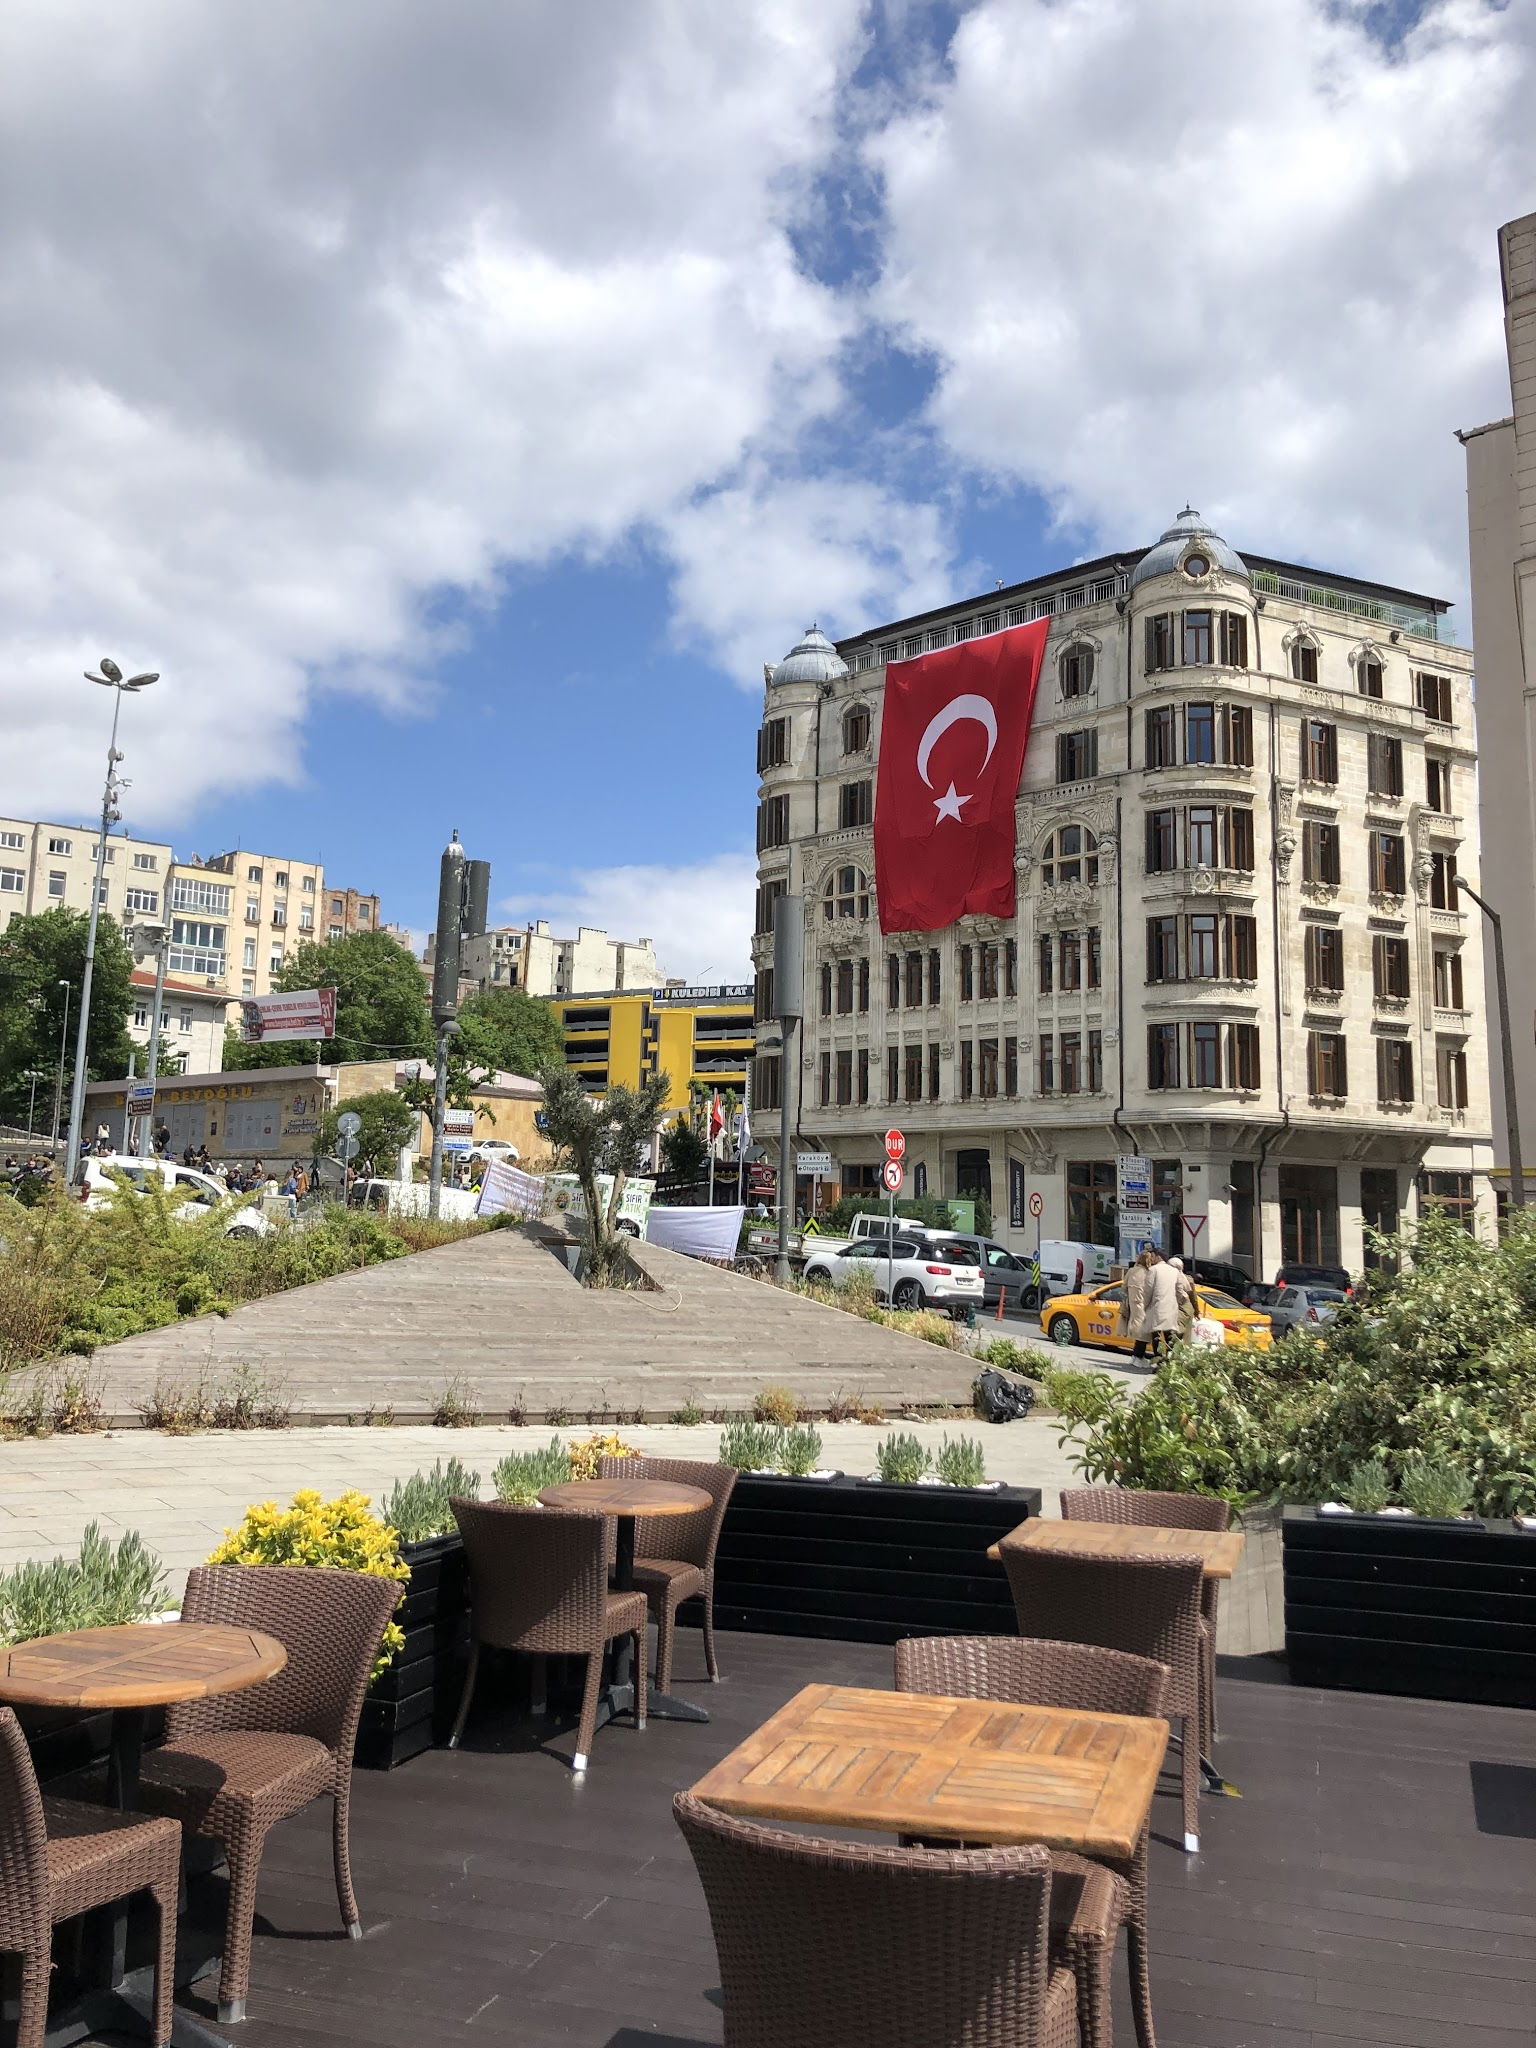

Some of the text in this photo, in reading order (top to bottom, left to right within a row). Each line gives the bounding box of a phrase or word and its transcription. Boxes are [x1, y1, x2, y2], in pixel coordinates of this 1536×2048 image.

[671, 986, 748, 998] KULEDİBİ KAT
[170, 1085, 252, 1102] BEYOĞLU
[887, 1138, 903, 1150] DUR
[798, 1154, 825, 1162] Karaköy
[802, 1164, 824, 1172] Otopark
[1088, 1322, 1112, 1336] TDS
